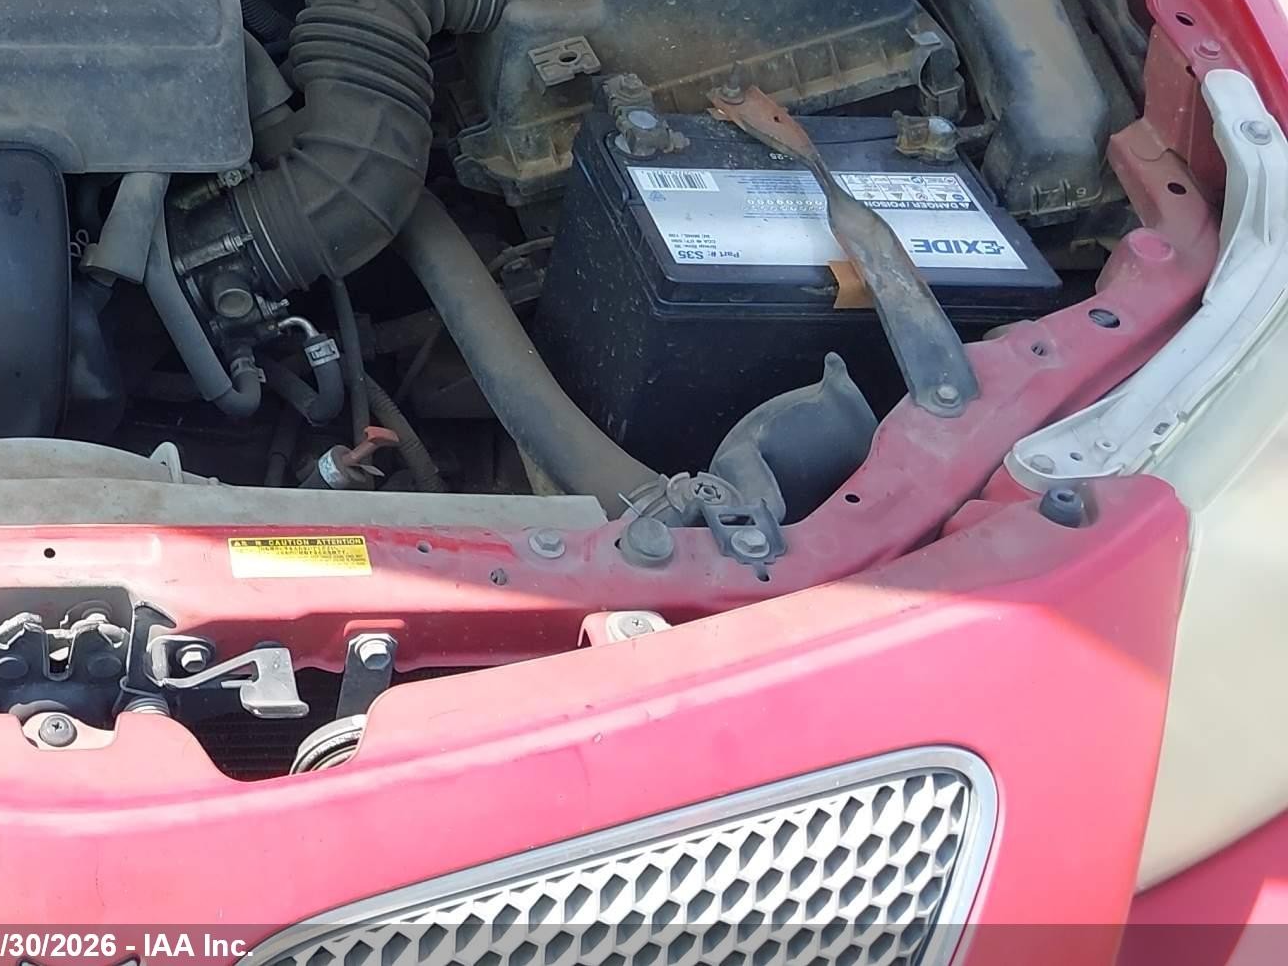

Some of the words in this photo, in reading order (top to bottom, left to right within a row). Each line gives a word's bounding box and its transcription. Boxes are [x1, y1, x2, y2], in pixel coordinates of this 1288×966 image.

[864, 200, 906, 209] POISON
[911, 201, 960, 210] DANGER
[910, 238, 1005, 254] EXIDE
[678, 250, 704, 260] S35
[719, 250, 740, 258] Part
